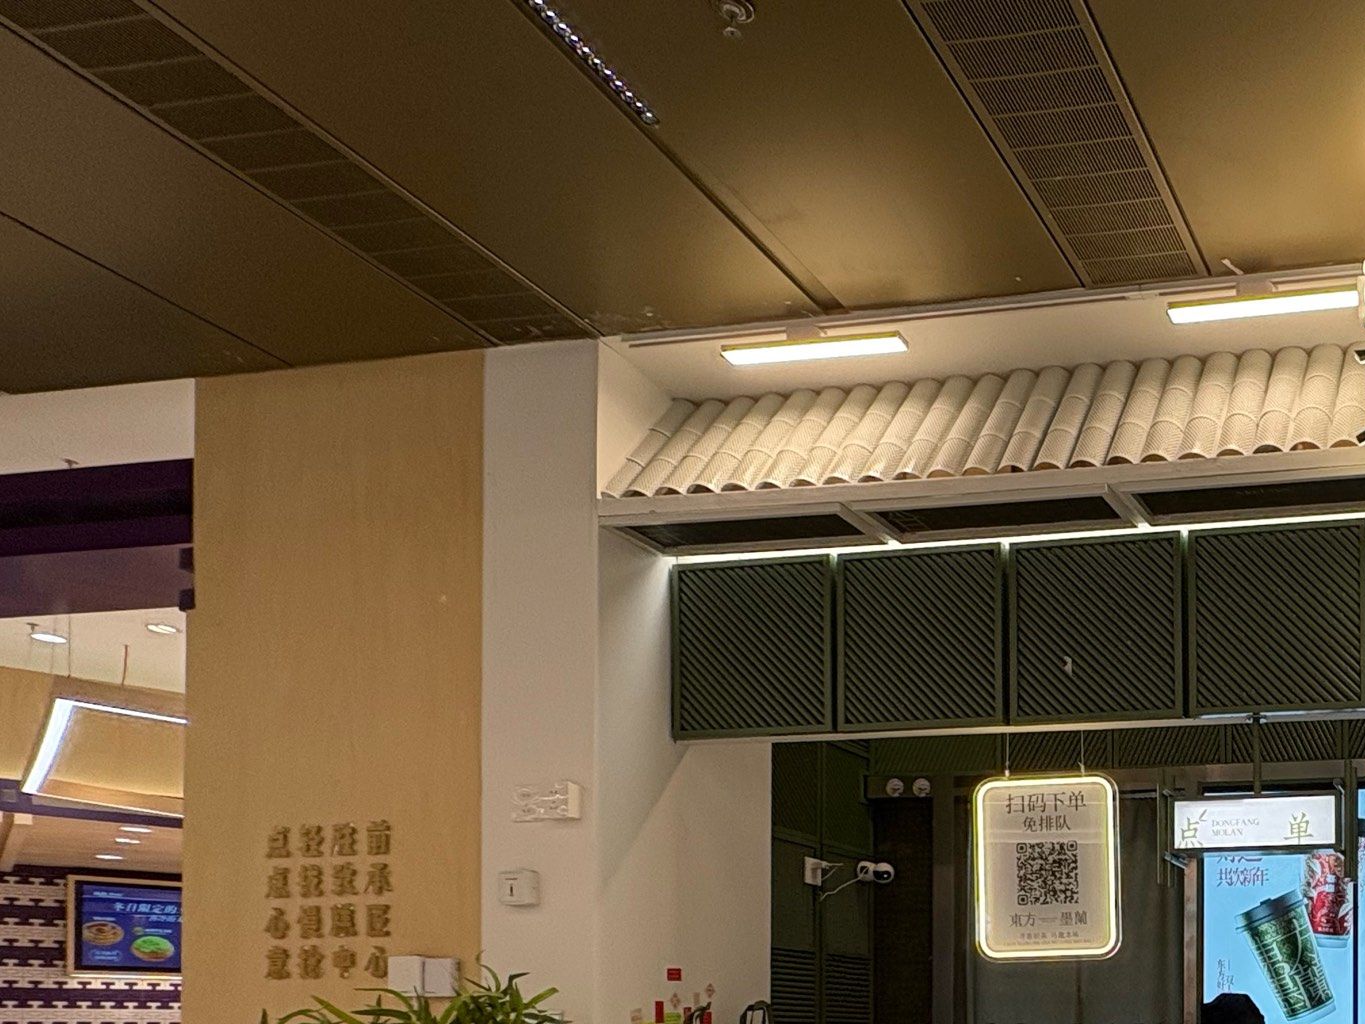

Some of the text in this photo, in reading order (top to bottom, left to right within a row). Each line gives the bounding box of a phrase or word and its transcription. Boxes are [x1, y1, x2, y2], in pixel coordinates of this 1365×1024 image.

[1005, 791, 1087, 814] 扫码下单
[1023, 815, 1071, 832] 免排队
[1178, 810, 1207, 847] 点
[1211, 818, 1260, 828] DONGFANG
[1283, 811, 1314, 846] 单
